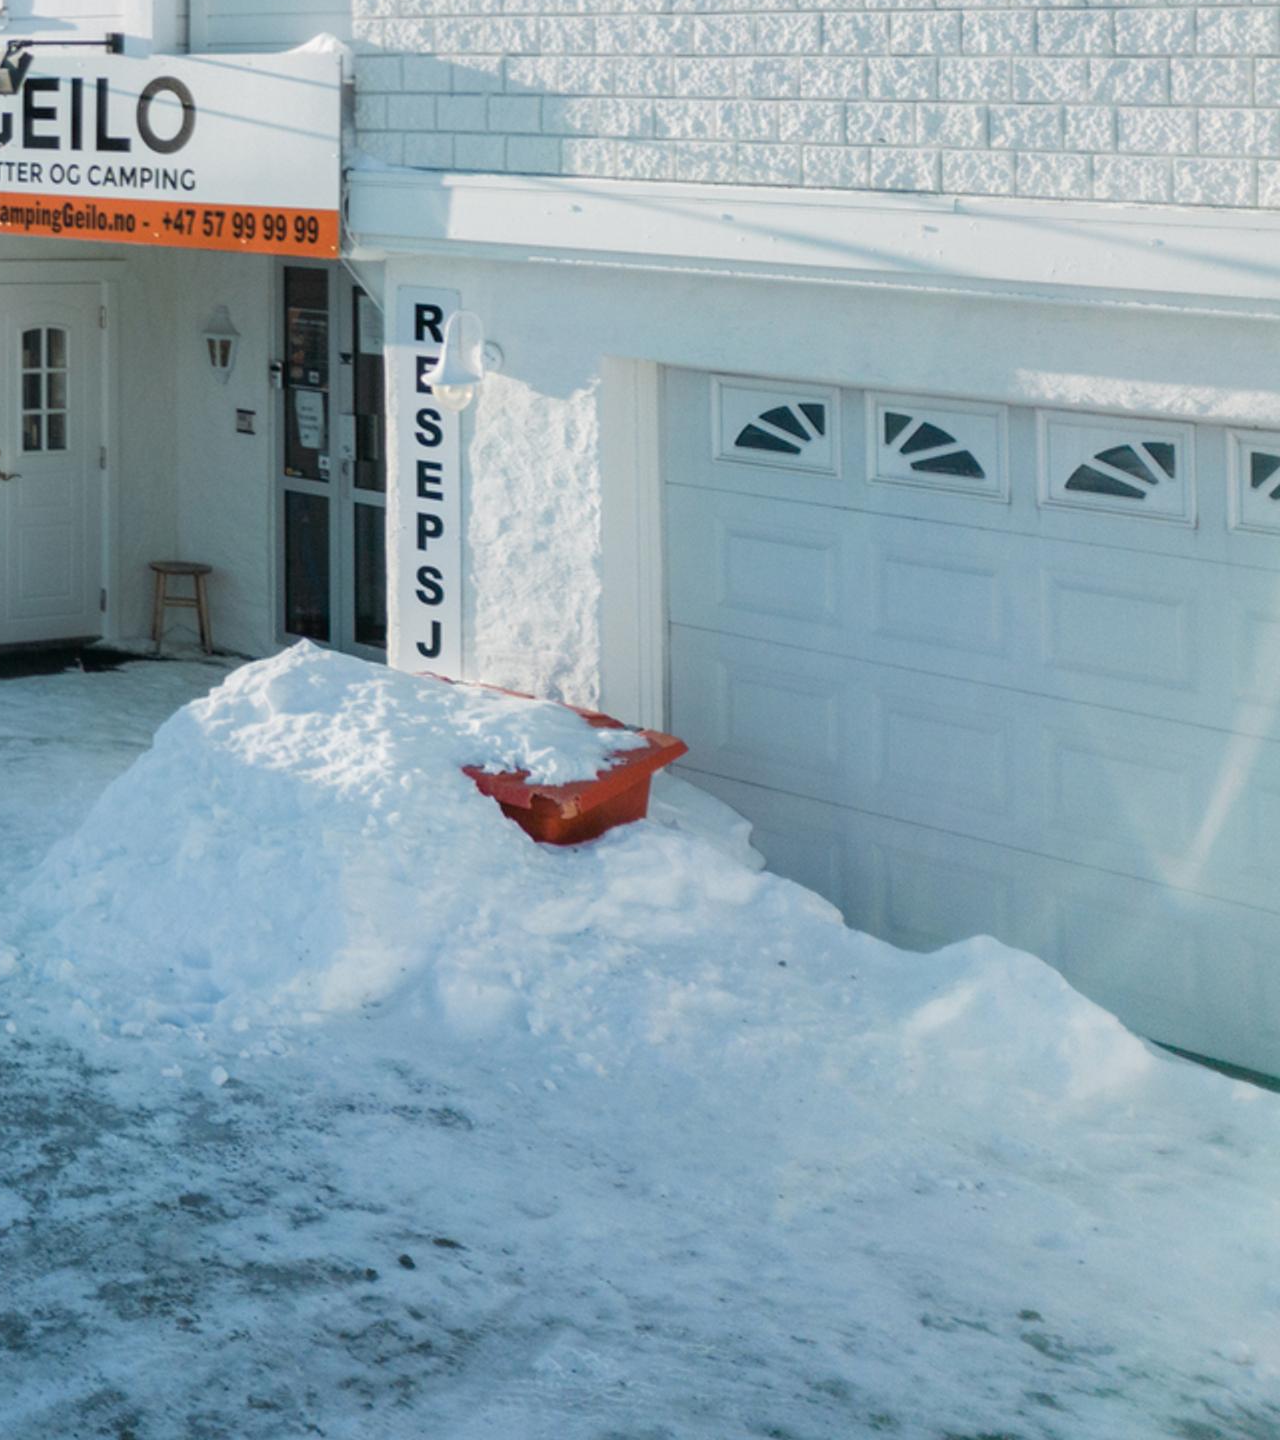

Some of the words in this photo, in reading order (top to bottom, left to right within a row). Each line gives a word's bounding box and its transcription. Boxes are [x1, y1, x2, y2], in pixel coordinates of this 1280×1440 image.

[49, 163, 81, 185] OG
[87, 165, 197, 191] CAMPING
[161, 208, 196, 236] +47
[202, 211, 226, 238] 57
[232, 212, 256, 240] 99
[262, 214, 288, 242] 99
[294, 215, 320, 245] 99
